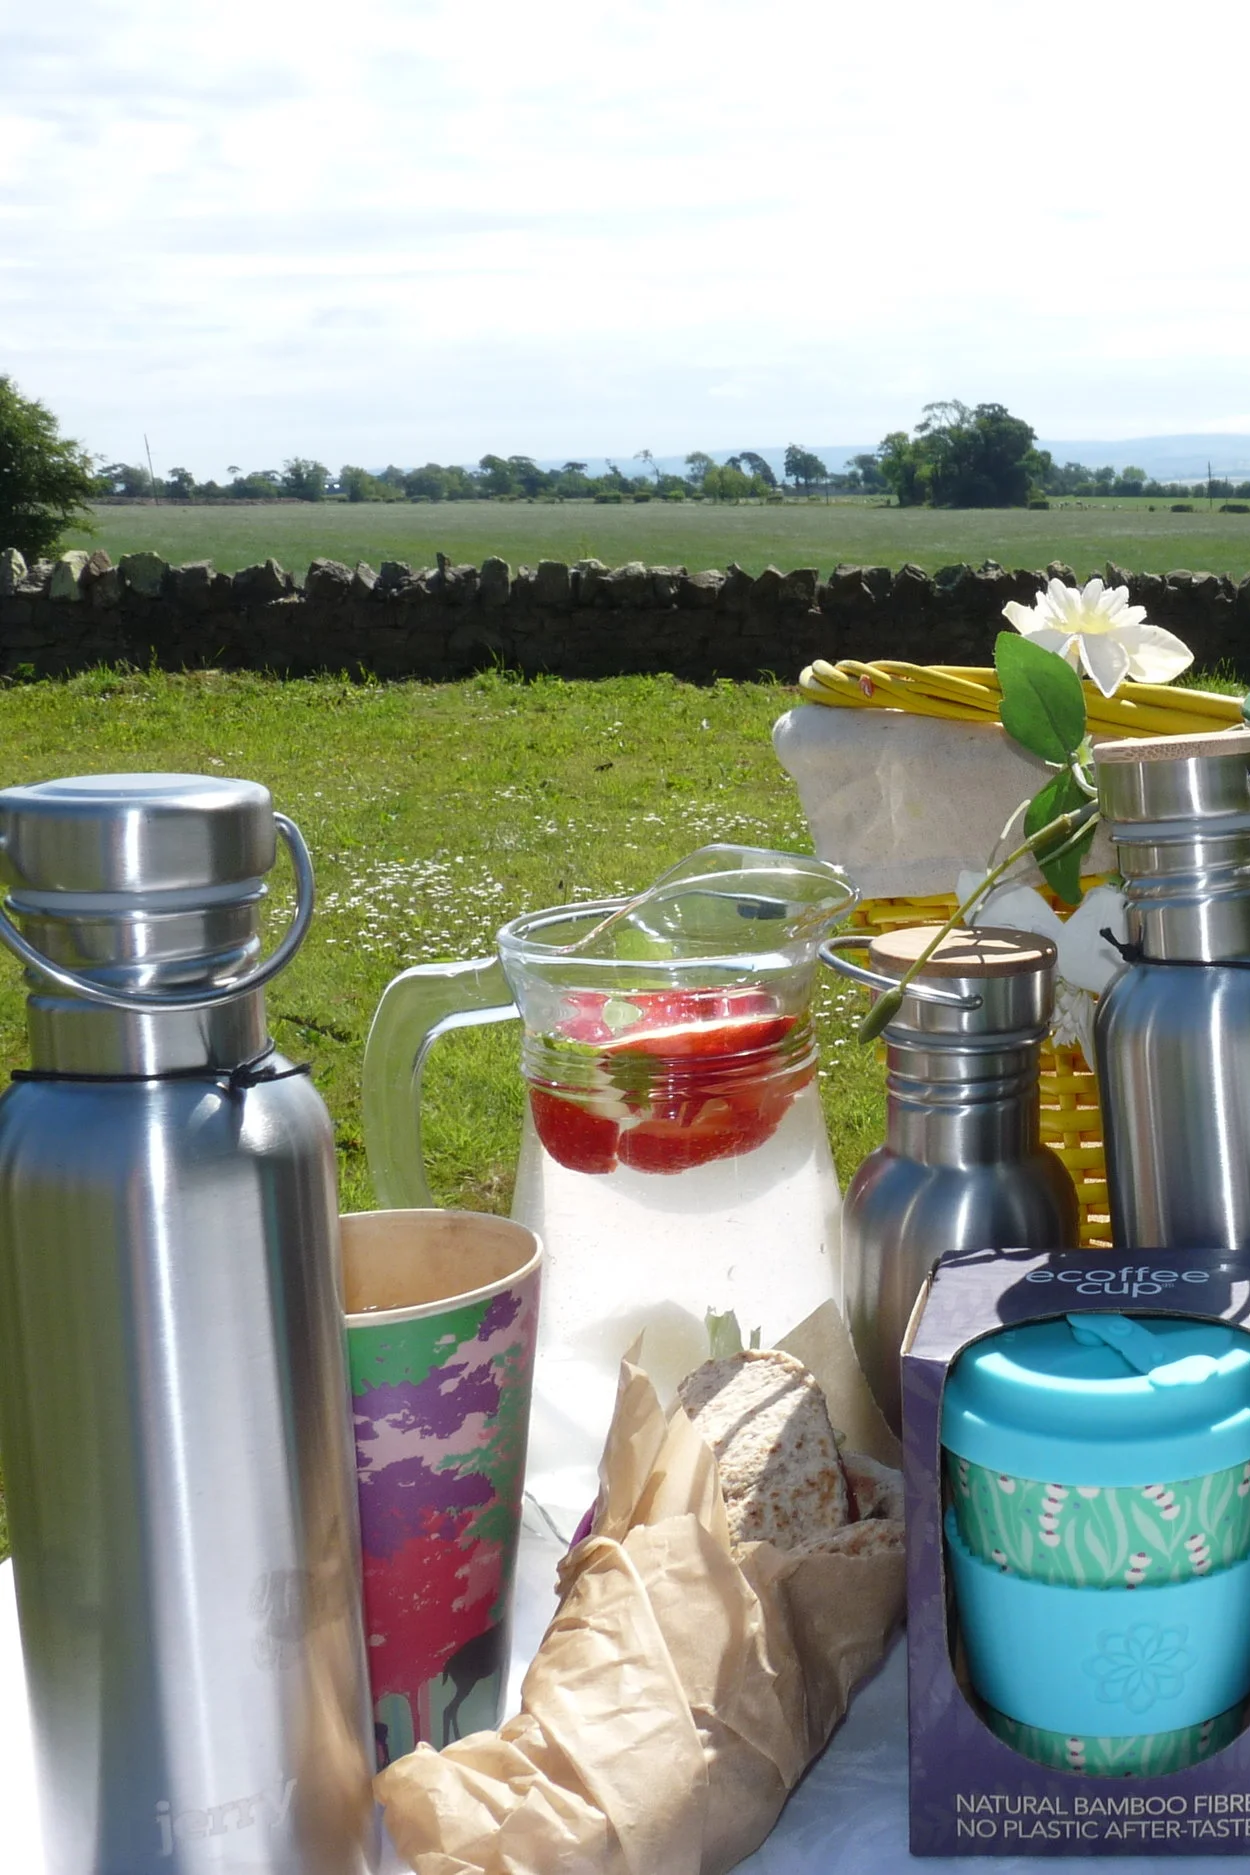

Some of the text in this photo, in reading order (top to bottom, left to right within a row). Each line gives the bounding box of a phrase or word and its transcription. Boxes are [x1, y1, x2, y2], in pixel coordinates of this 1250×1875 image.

[1025, 1266, 1210, 1283] ecoffee
[1076, 1281, 1162, 1298] cup
[155, 1772, 298, 1856] jerry
[956, 1793, 1068, 1815] NATURAL
[1074, 1795, 1187, 1816] BAMBOO
[956, 1819, 996, 1839] NO
[1004, 1819, 1099, 1839] PLASTIC
